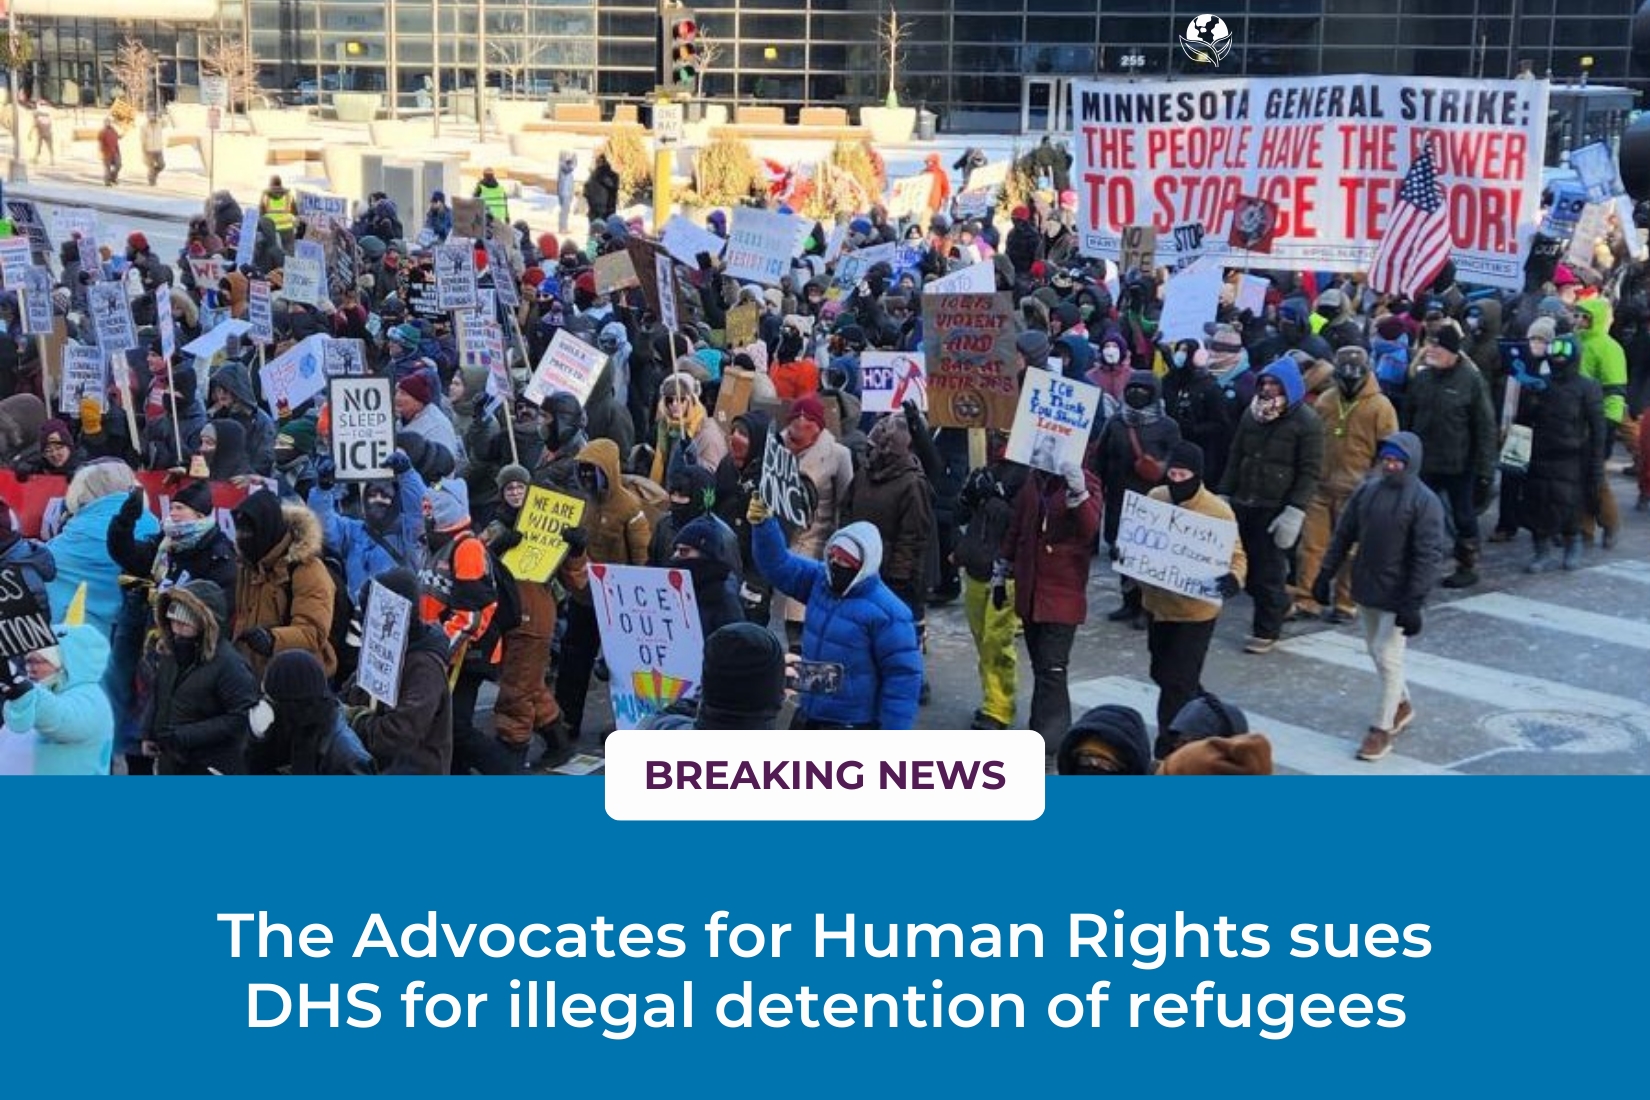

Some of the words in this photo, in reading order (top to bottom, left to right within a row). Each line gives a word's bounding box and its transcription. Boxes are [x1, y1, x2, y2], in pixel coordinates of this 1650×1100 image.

[1121, 55, 1146, 67] 255
[1082, 90, 1249, 123] MINNESOTA
[1264, 85, 1384, 120] GENERAL
[1400, 88, 1530, 126] STRIKE:
[1082, 126, 1137, 170] THE
[1148, 124, 1252, 170] PEOPLE
[1257, 124, 1324, 169] HAVE
[1338, 125, 1398, 171] THE
[1410, 126, 1527, 181] POWER
[1084, 173, 1135, 232] TO
[1152, 174, 1243, 235] STOP
[1339, 176, 1522, 254] TEOR!
[1174, 223, 1205, 252] STOP
[193, 262, 220, 279] WE
[935, 312, 1008, 329] VIOLENT
[943, 333, 993, 353] AND
[343, 387, 382, 412] NO
[339, 412, 388, 429] SLEEP
[352, 430, 373, 439] FOR
[339, 440, 387, 471] ICE
[533, 494, 550, 513] WE
[551, 502, 576, 520] ARE
[1125, 492, 1162, 526] Hey
[616, 583, 671, 611] ICE
[619, 612, 674, 641] OUT
[638, 644, 667, 667] OF
